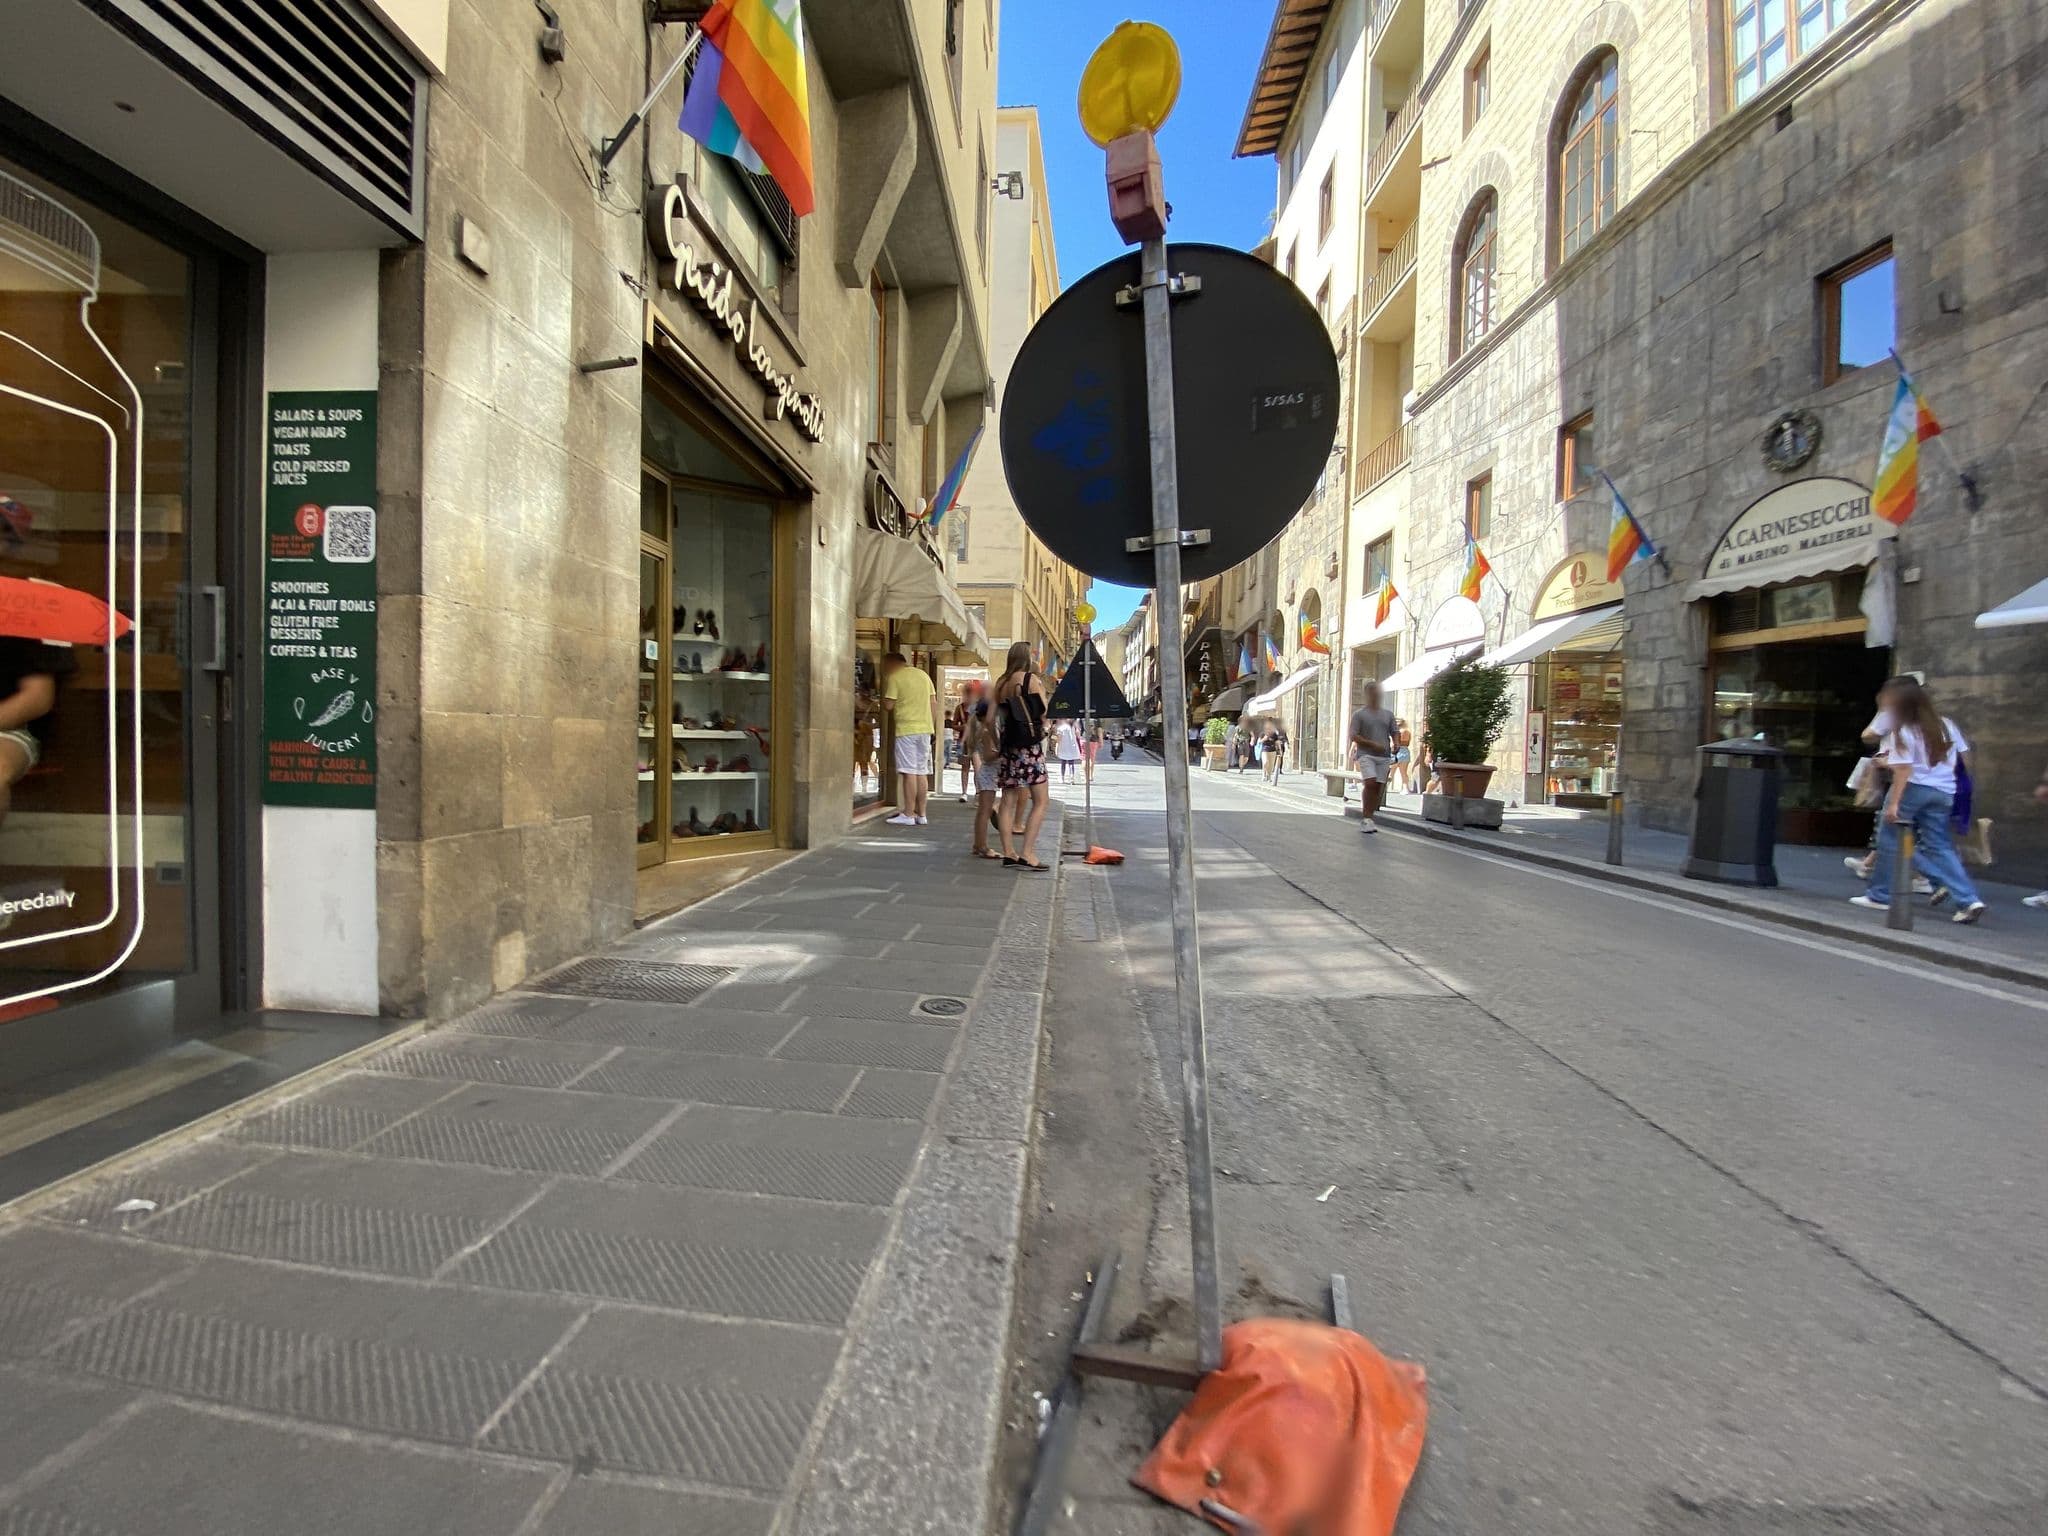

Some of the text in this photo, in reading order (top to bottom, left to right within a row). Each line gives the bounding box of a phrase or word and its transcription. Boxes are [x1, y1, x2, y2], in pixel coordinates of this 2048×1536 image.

[274, 409, 363, 421] SALADS & SOUPS
[273, 426, 347, 438] VEGAN WRAPS
[273, 444, 311, 455] TOASTS
[273, 461, 350, 472] COLD PRESSED
[272, 473, 307, 485] JUICES
[1719, 557, 1731, 570] di
[1737, 544, 1790, 565] MARINO
[271, 582, 330, 594] SMOOTHIES
[298, 599, 307, 611] &
[309, 600, 338, 611] FRUIT
[340, 600, 376, 612] BOWLS
[270, 615, 340, 628] GLUTEN FREE
[270, 627, 323, 640] DESSERTS
[270, 645, 358, 658] COFFEES & TEAS
[311, 667, 360, 684] BASE V
[303, 732, 361, 753] JUICERY
